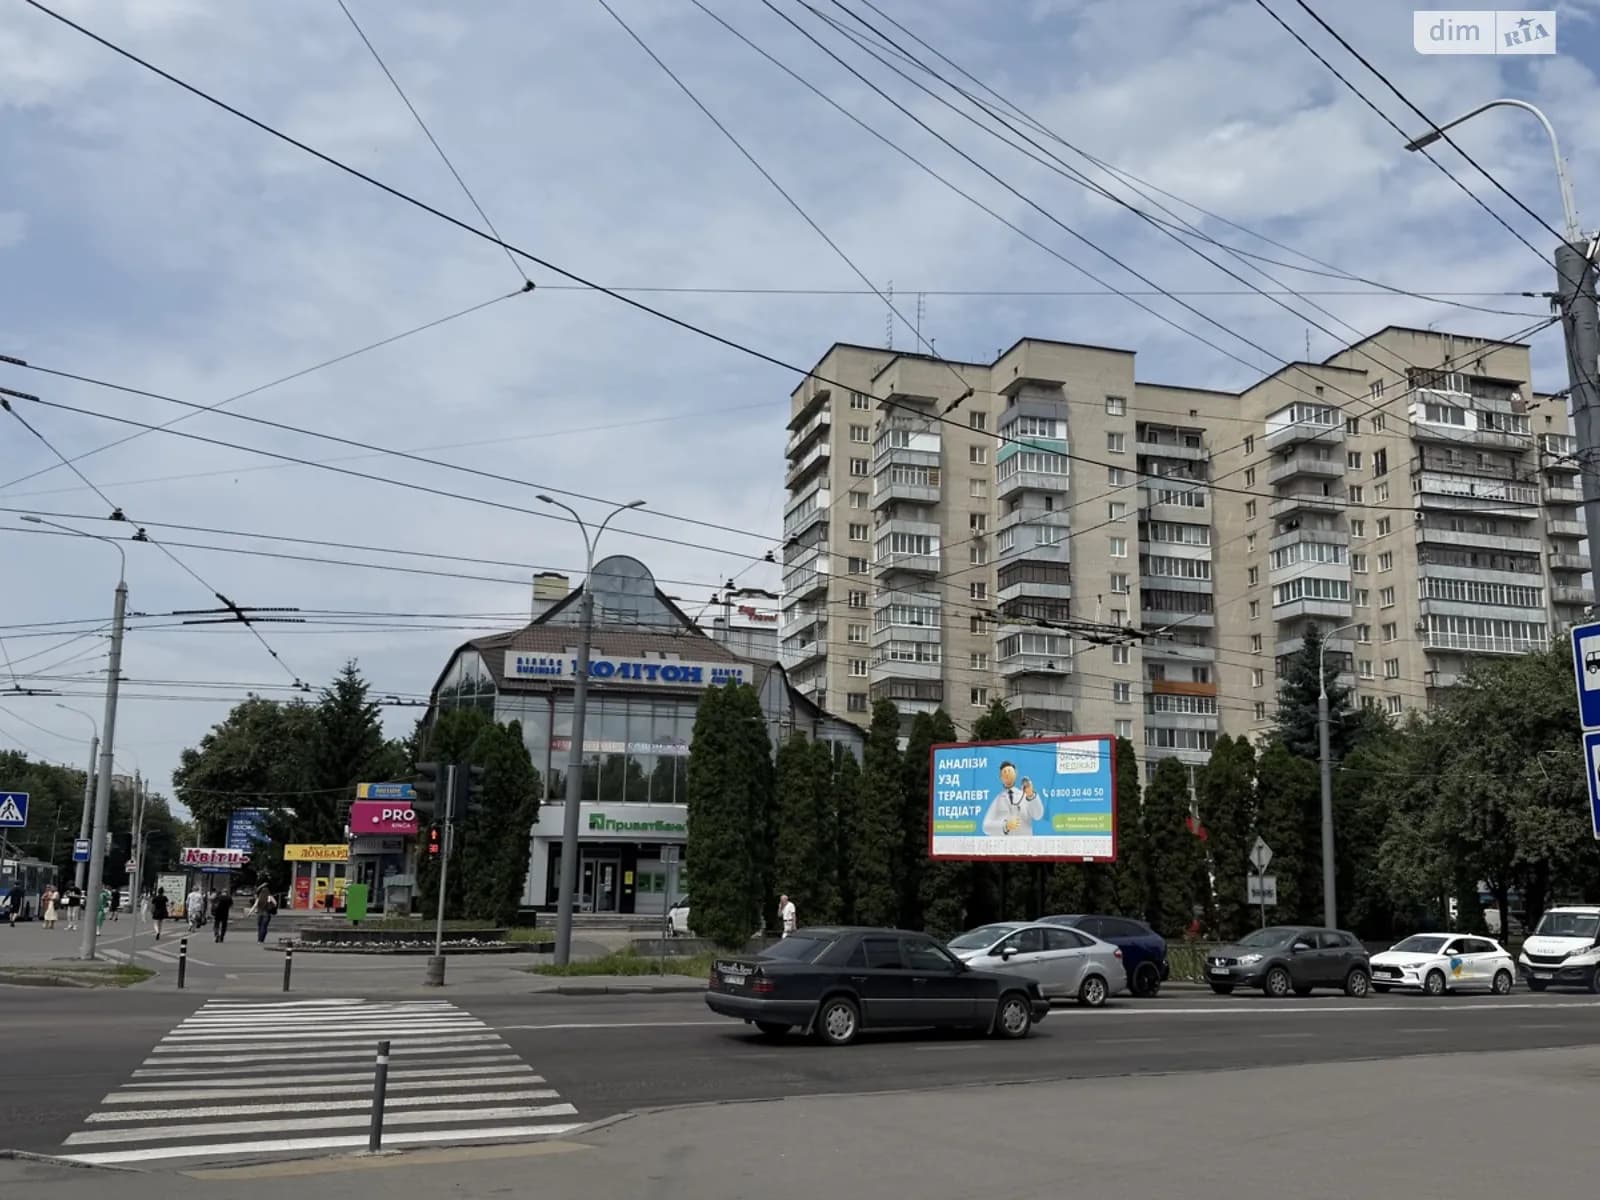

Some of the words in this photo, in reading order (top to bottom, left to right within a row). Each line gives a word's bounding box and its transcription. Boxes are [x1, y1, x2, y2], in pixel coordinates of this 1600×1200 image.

[938, 758, 988, 770] АНАЛІЗИ
[938, 774, 960, 787] УЗД
[938, 790, 990, 801] ТЕРАПЕВТ
[1071, 788, 1081, 797] 30
[1082, 788, 1092, 797] 40
[1094, 787, 1104, 797] 50
[382, 809, 416, 822] PRO
[938, 806, 982, 819] ПЕДІАТР
[185, 849, 241, 864] Квіти
[300, 848, 349, 859] ЛОМБАРД
